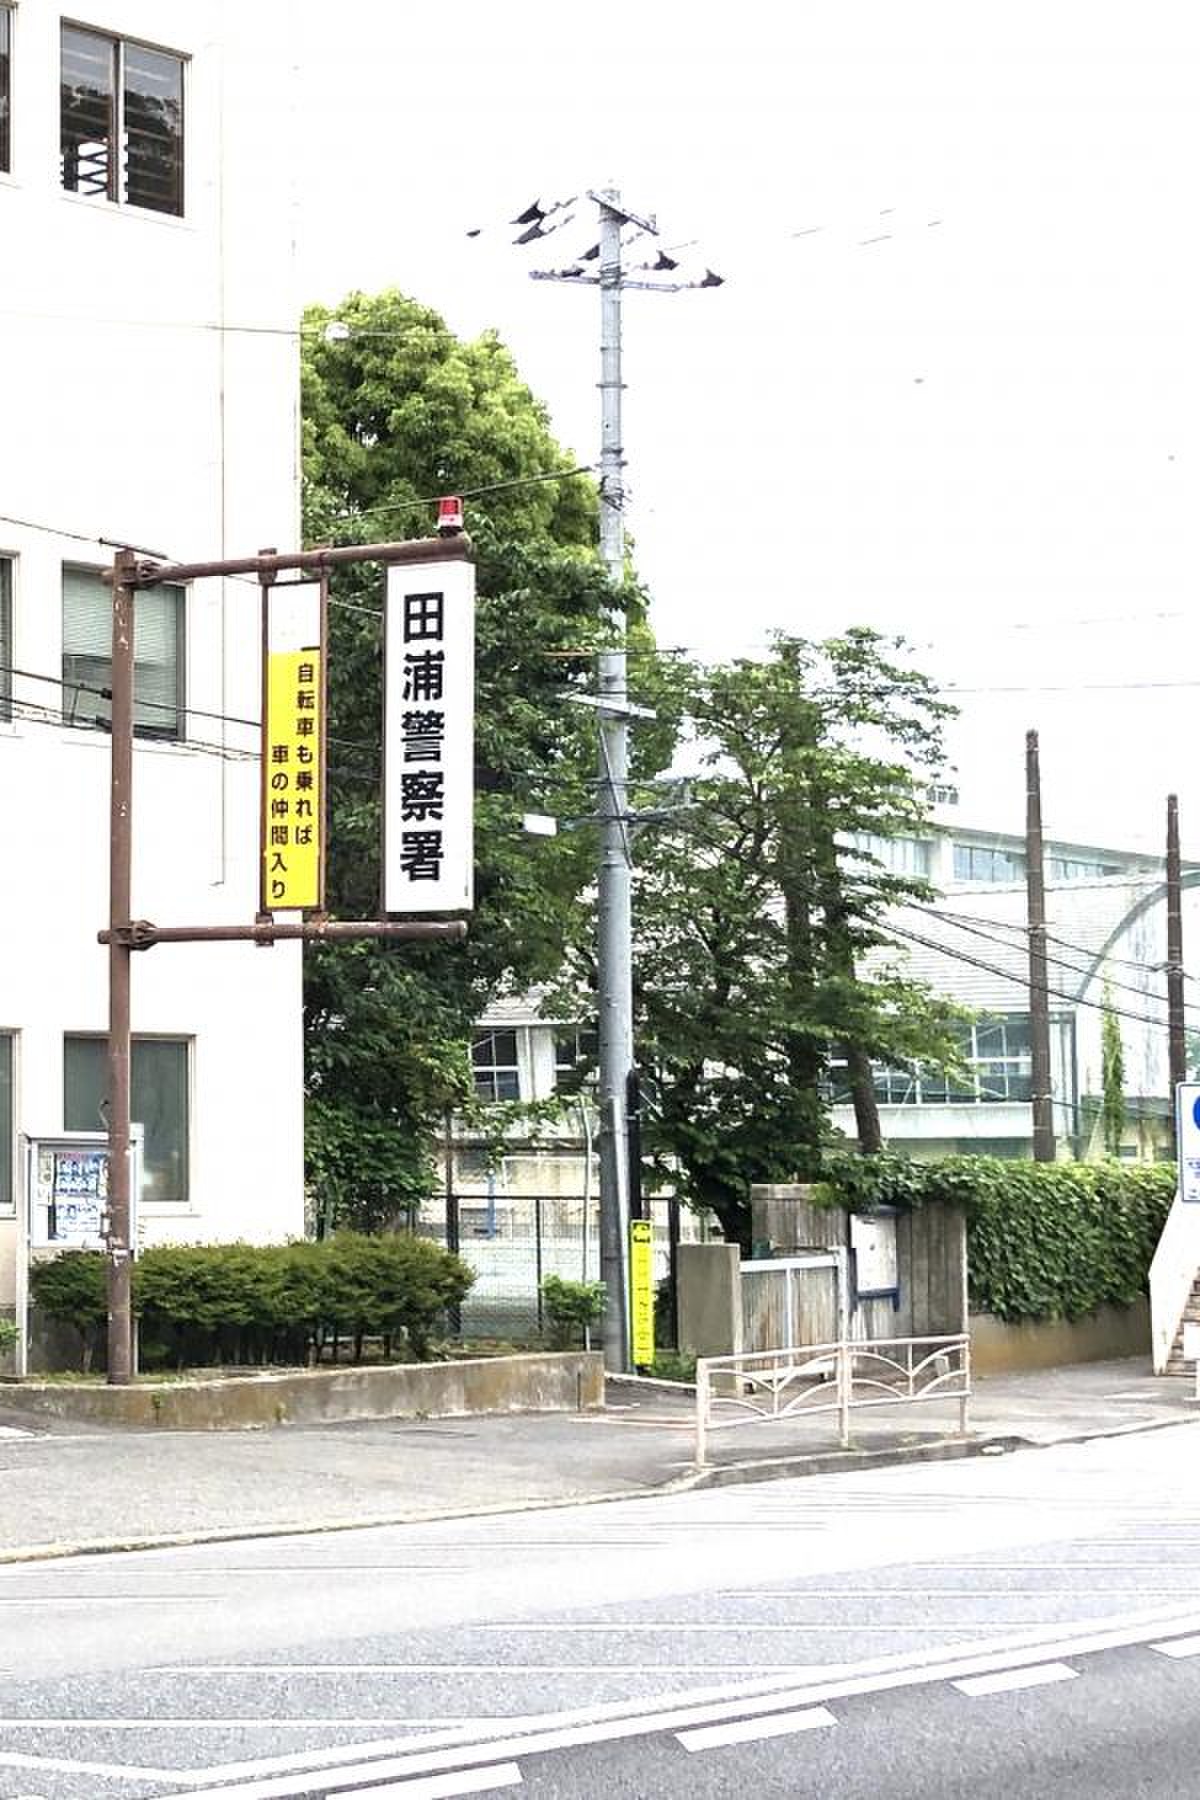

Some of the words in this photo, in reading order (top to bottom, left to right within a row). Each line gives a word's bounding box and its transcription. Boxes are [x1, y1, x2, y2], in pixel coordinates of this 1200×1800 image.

[271, 745, 289, 899] 車の仲間入り
[295, 662, 314, 845] 自転車も乗れば
[400, 591, 445, 882] 田浦警察署
